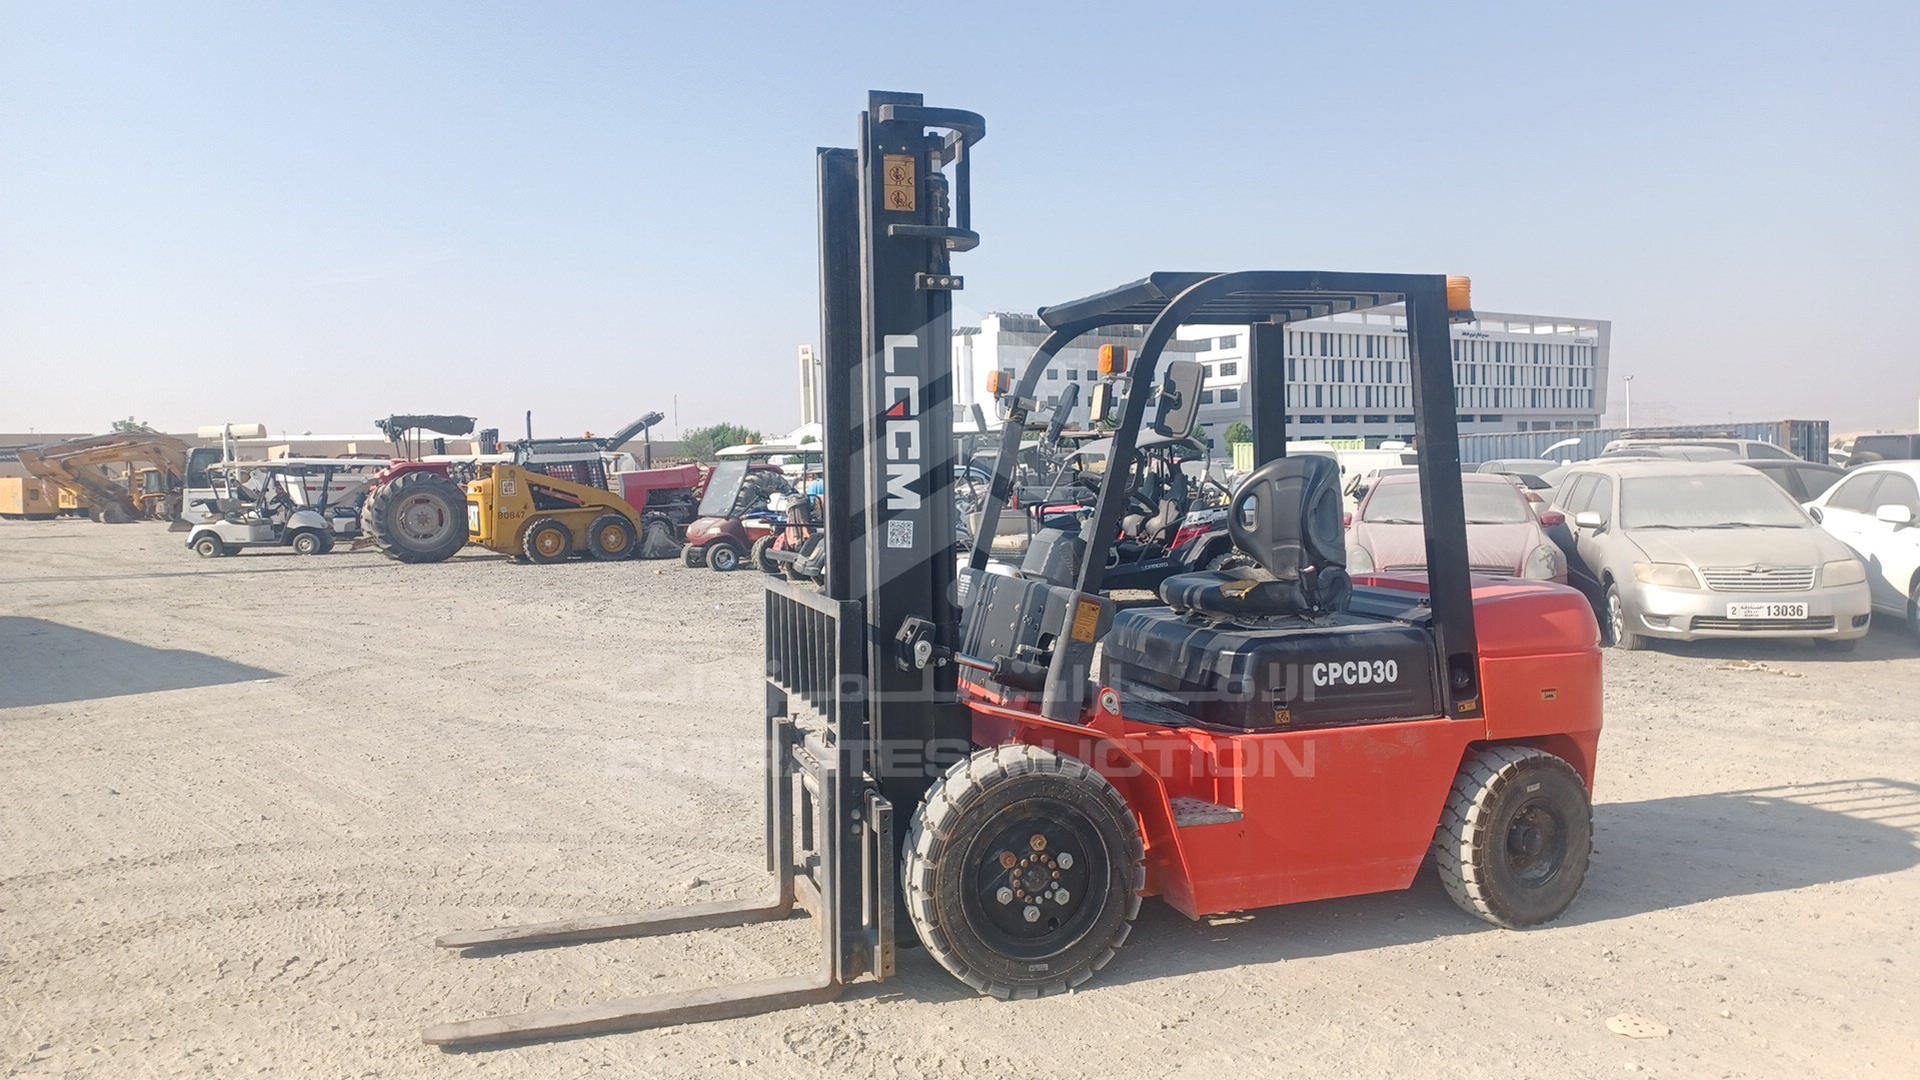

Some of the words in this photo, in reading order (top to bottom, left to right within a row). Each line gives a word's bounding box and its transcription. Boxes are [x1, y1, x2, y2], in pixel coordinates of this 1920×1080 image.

[1731, 606, 1737, 616] 2
[1766, 605, 1804, 617] 13036
[1312, 659, 1398, 687] CPCD30
